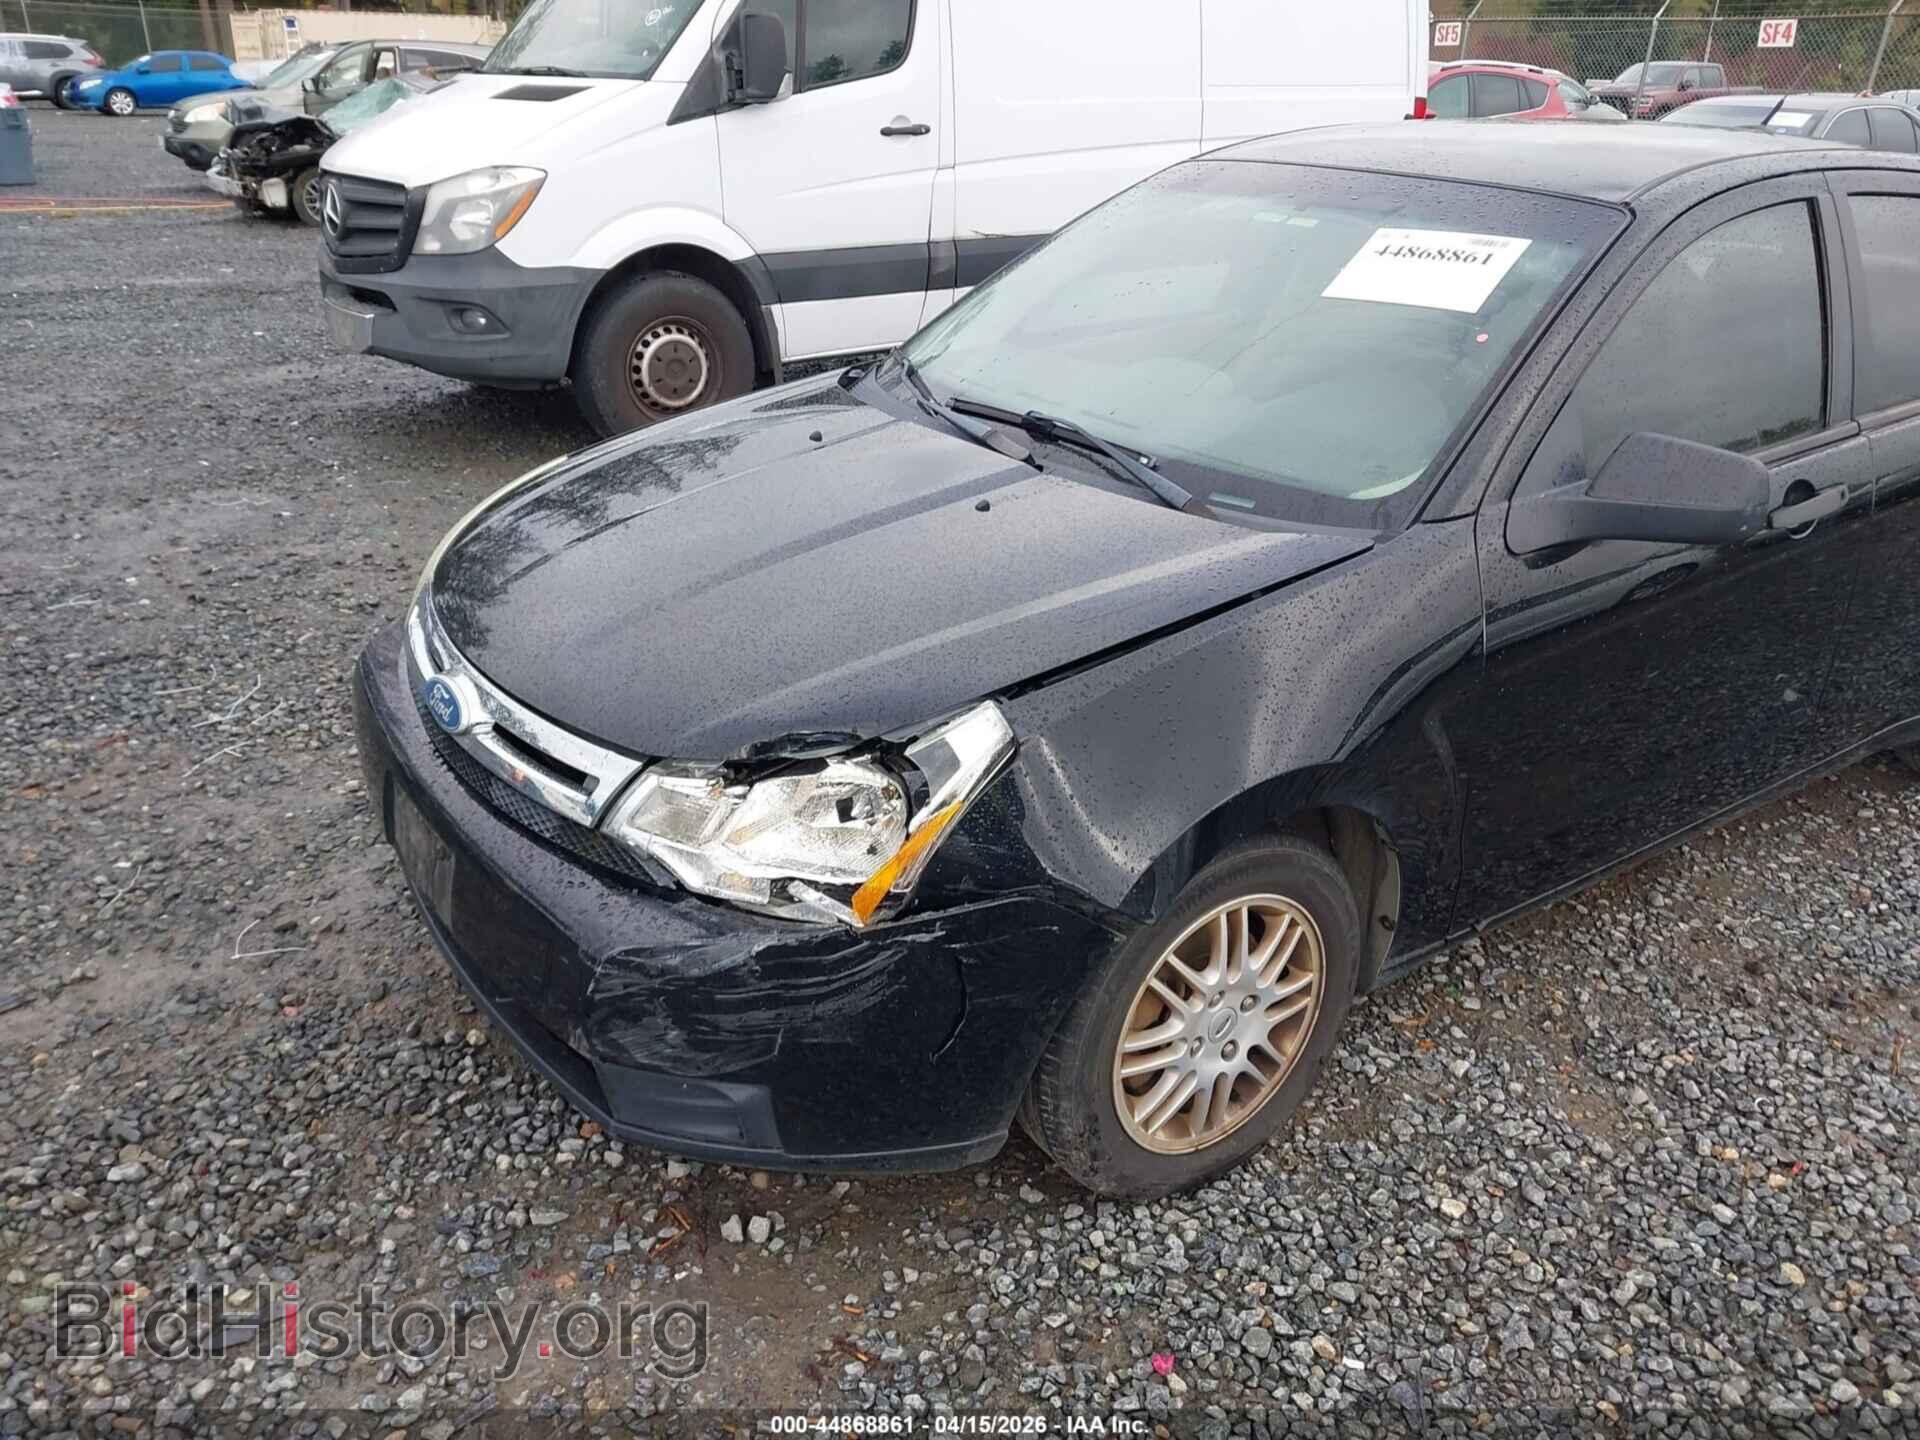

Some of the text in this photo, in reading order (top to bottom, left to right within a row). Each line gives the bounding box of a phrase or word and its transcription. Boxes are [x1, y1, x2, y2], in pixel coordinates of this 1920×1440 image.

[1437, 24, 1459, 43] SF5
[1761, 23, 1793, 44] SF4
[1374, 244, 1494, 265] 44868861
[428, 683, 454, 722] Ford
